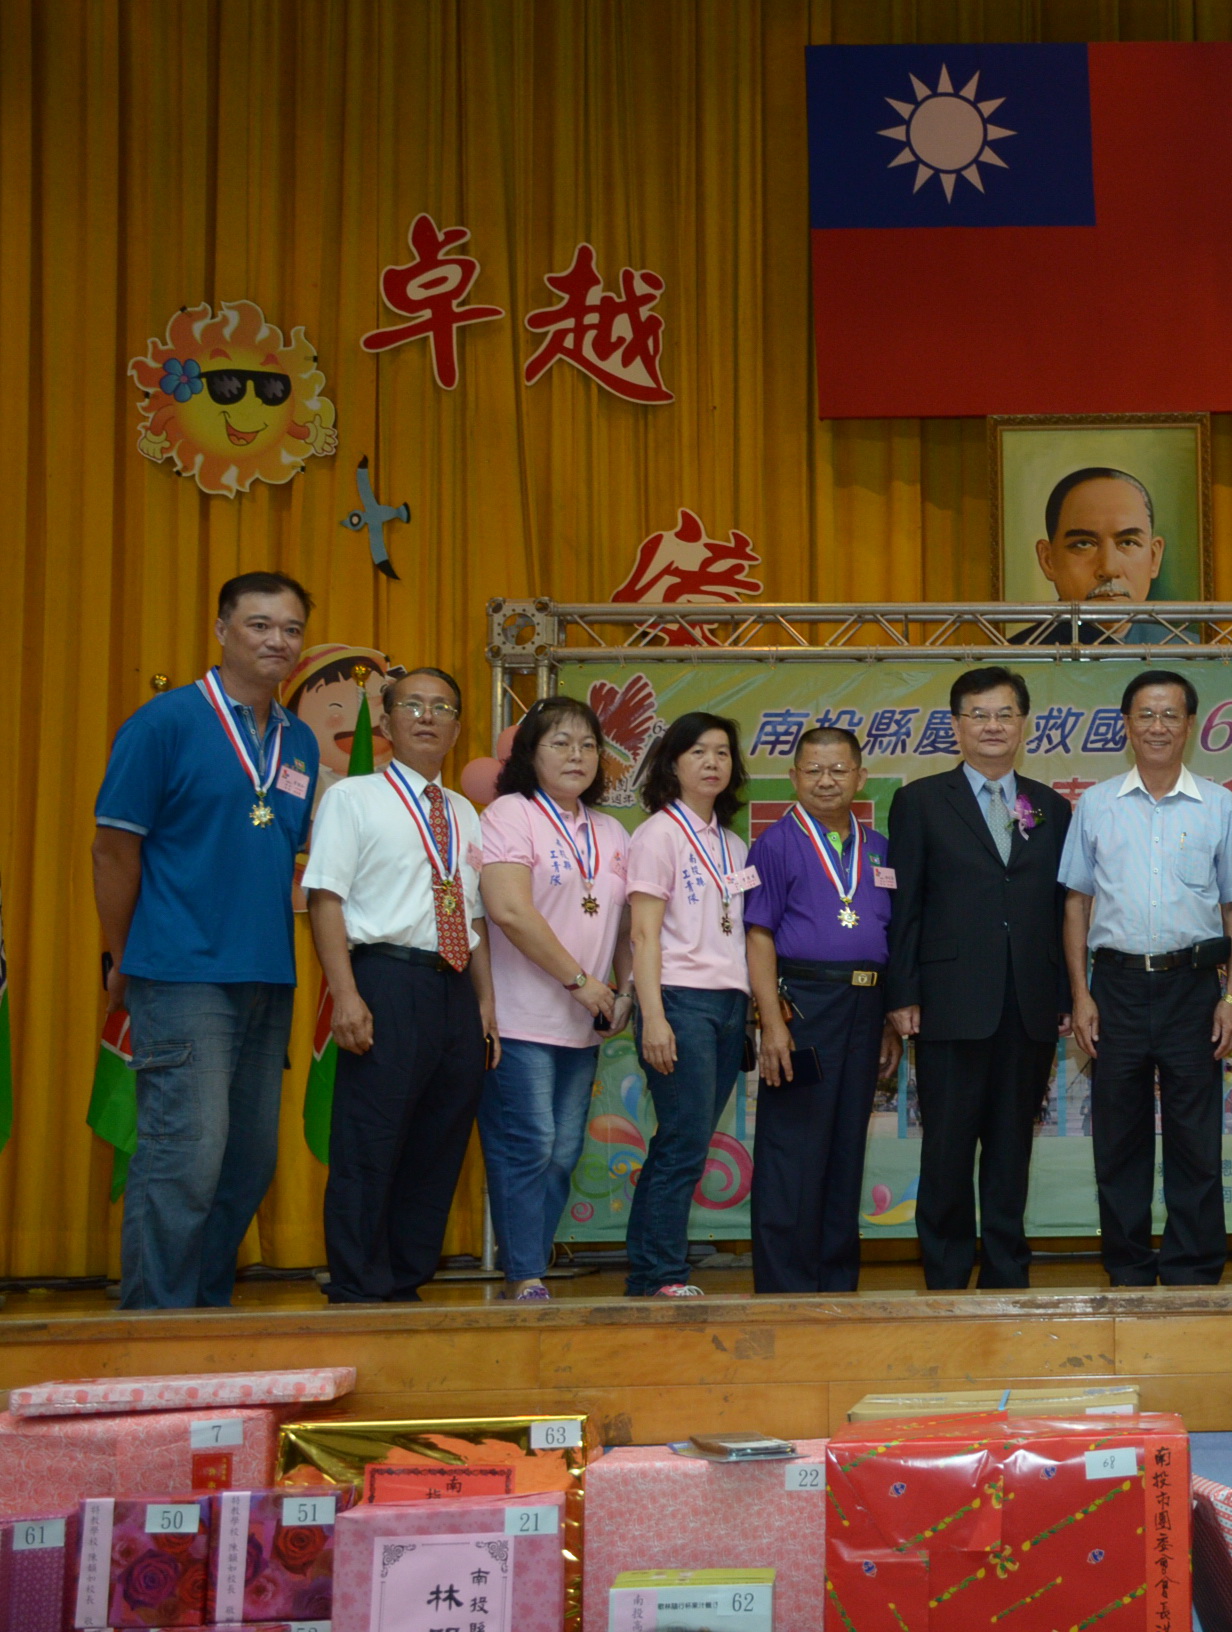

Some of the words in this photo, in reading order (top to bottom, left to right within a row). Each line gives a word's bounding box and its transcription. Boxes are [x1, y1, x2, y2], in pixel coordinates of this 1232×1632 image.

[360, 212, 675, 405] 卓越
[212, 1425, 222, 1443] 7
[545, 1426, 567, 1445] 63
[1103, 1456, 1116, 1469] 68
[446, 1476, 462, 1493] 南
[798, 1469, 819, 1488] 22
[160, 1510, 184, 1530] 50
[297, 1503, 317, 1522] 51
[519, 1512, 542, 1532] 21
[25, 1526, 46, 1545] 61
[732, 1592, 754, 1612] 62
